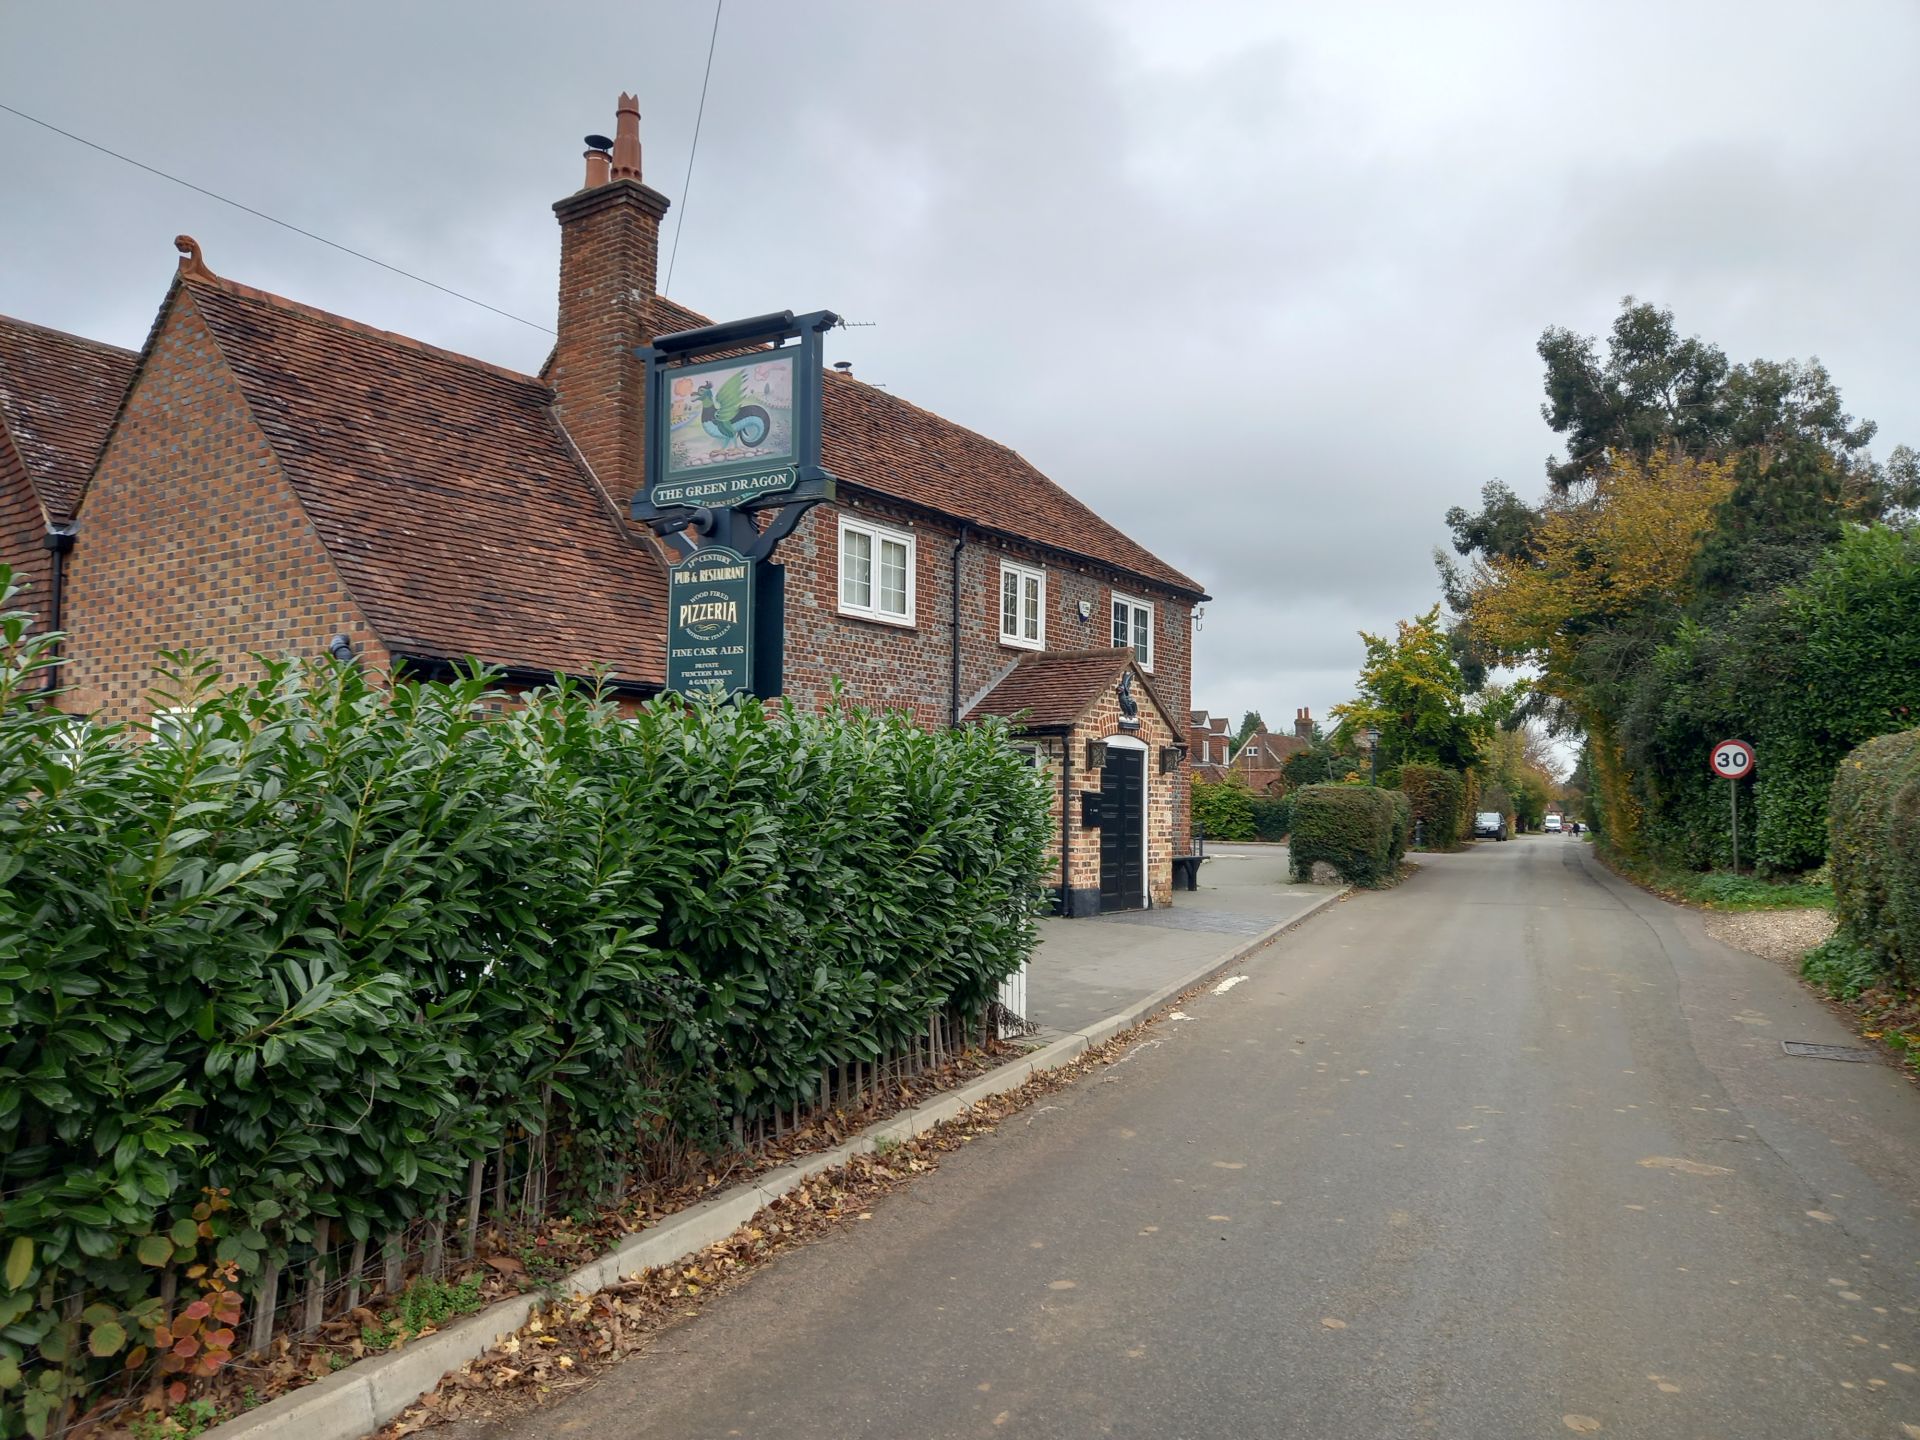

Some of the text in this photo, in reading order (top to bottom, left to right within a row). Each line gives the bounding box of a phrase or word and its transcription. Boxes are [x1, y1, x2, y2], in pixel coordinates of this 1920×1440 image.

[657, 473, 788, 501] THE GREEN DRAGON
[698, 553, 732, 565] CENTURY
[674, 565, 746, 585] PUB & RESTAURANT
[689, 590, 729, 603] WOOD FIRED
[680, 601, 738, 628] PIZZERIA
[672, 645, 744, 657] FINE CASK ALES
[1717, 752, 1747, 767] 30
